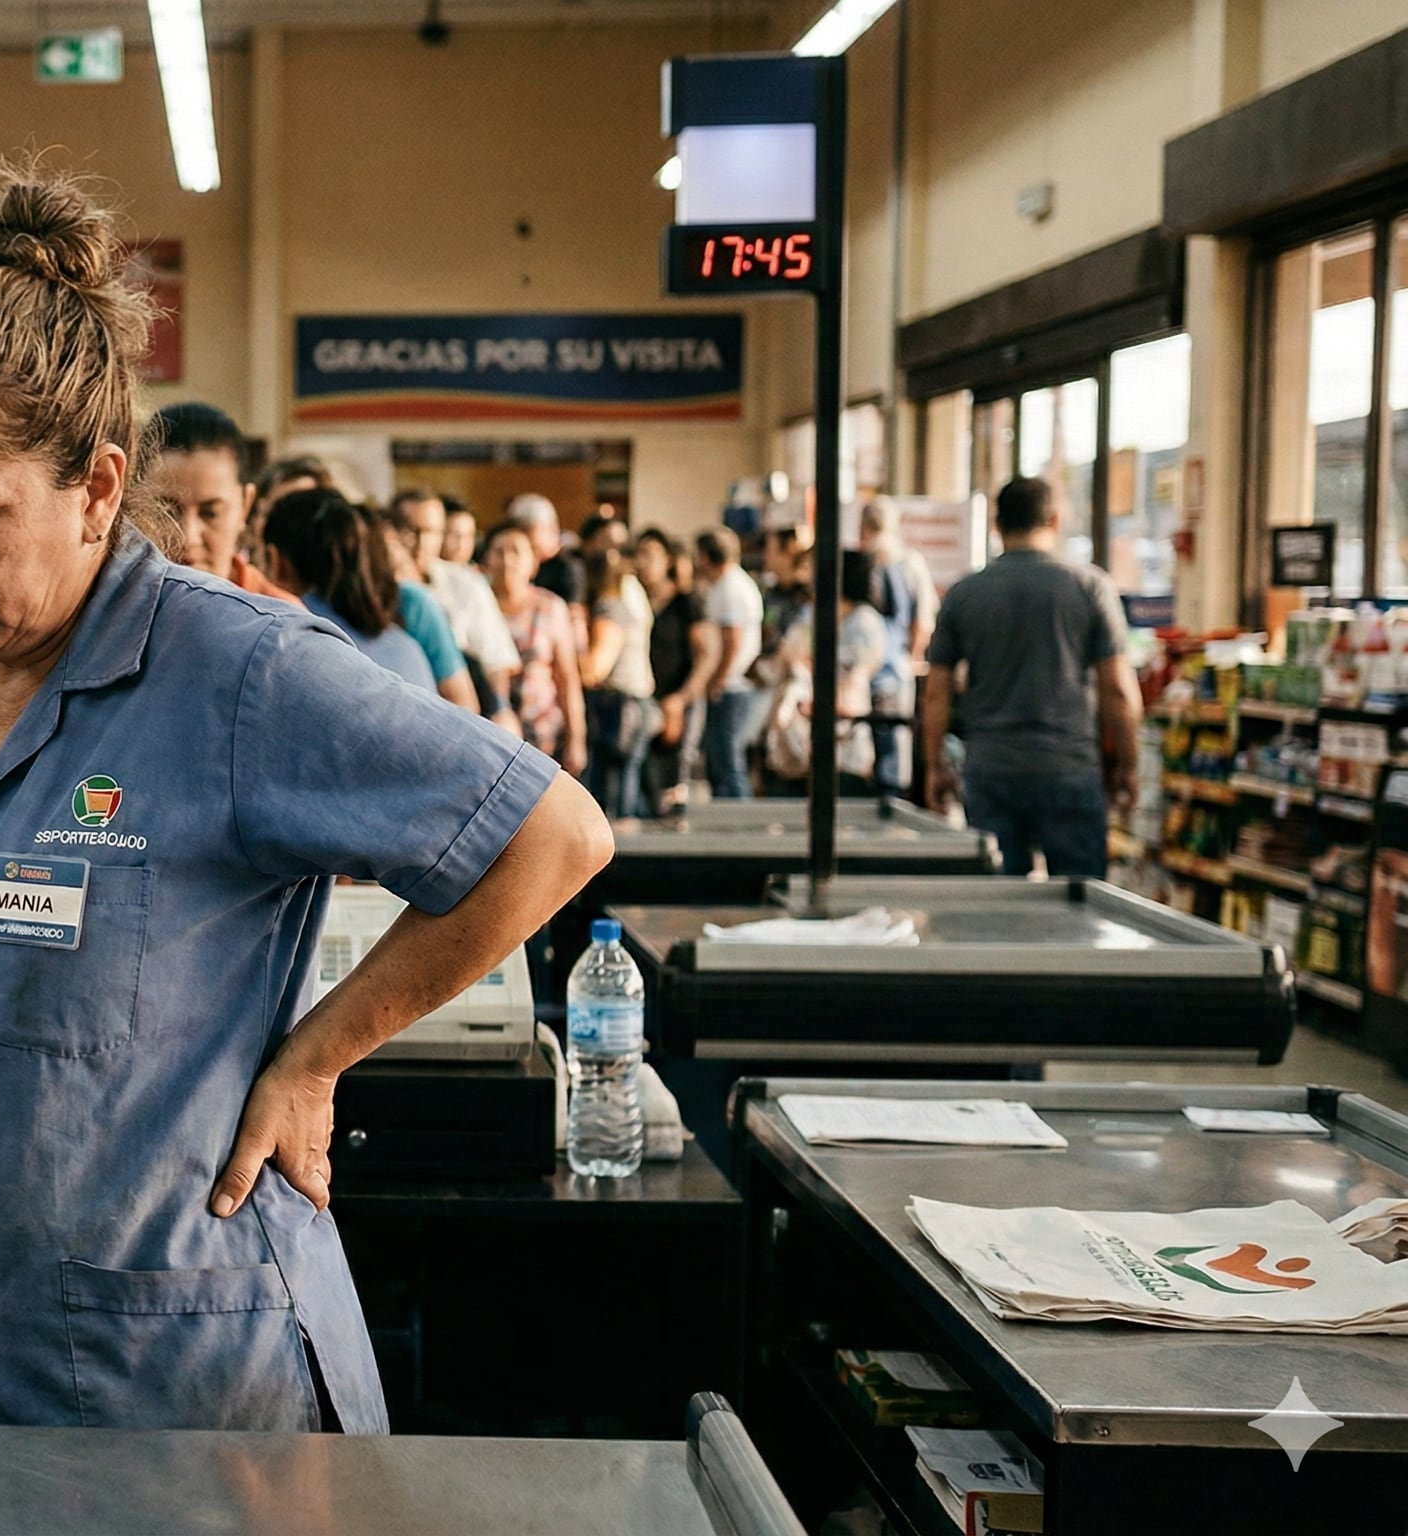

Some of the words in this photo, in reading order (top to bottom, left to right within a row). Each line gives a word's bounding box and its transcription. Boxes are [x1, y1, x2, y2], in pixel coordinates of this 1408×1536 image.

[701, 233, 812, 279] 17:45
[313, 338, 468, 373] GRACIAS
[475, 339, 550, 373] POR
[556, 339, 604, 373] SU
[610, 339, 723, 373] VISITA
